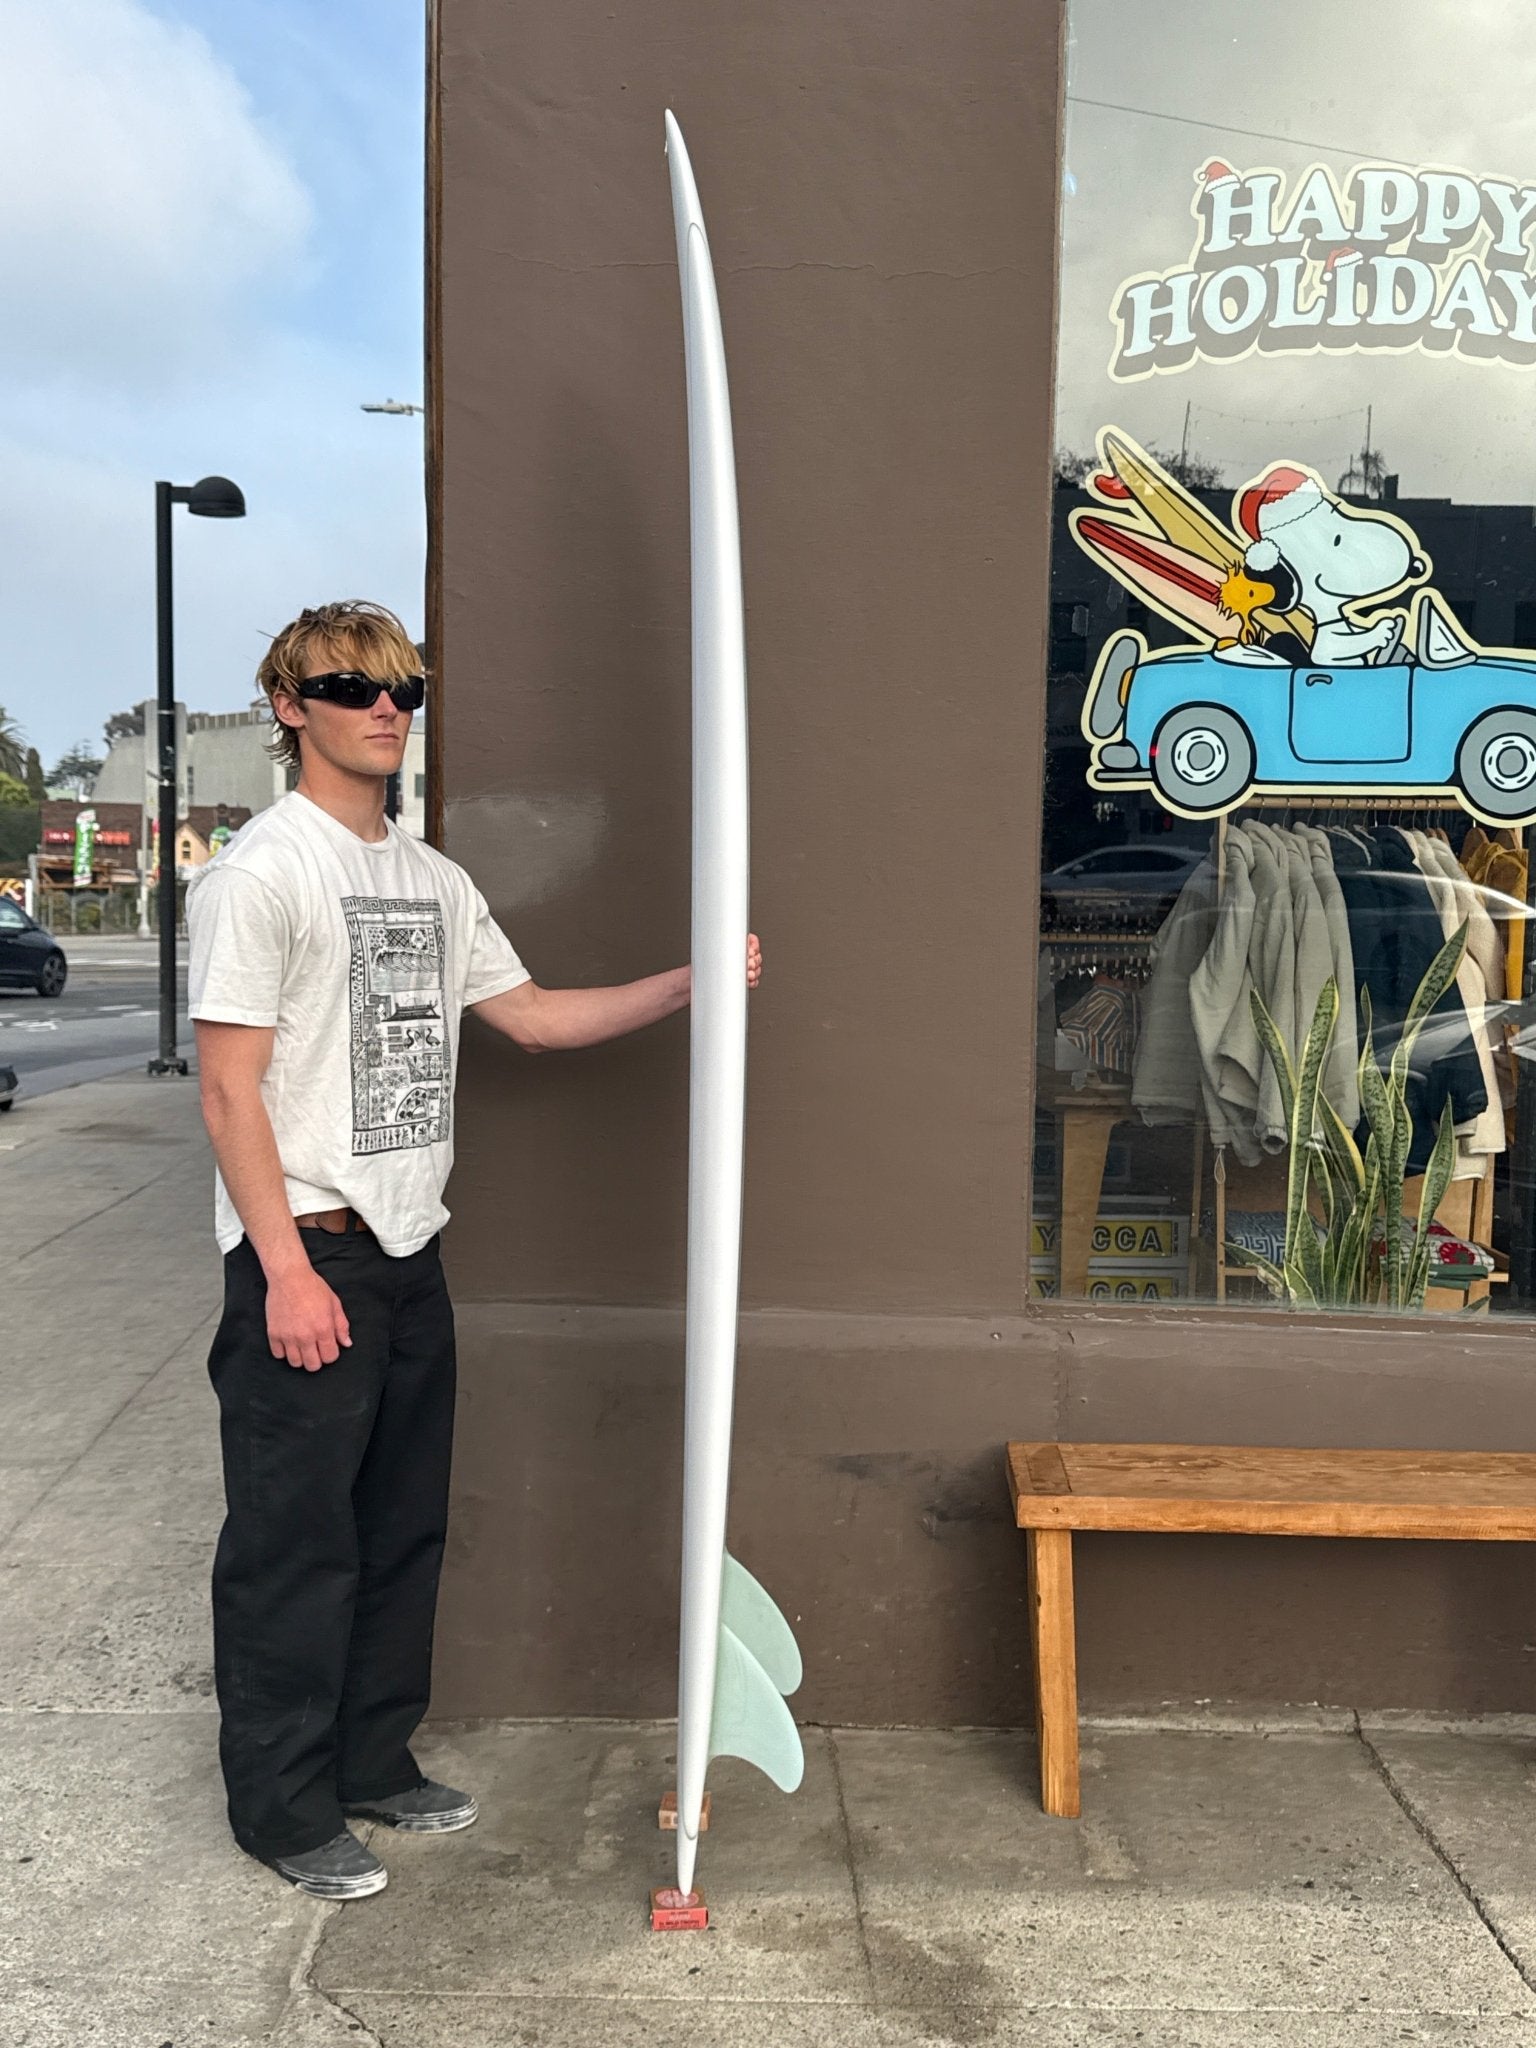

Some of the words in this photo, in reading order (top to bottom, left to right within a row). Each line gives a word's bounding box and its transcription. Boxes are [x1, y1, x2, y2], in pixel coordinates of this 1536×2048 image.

[1201, 168, 1536, 256] HAPPY
[1121, 256, 1536, 358] HOLIDAY
[1036, 1225, 1163, 1252] YCCA
